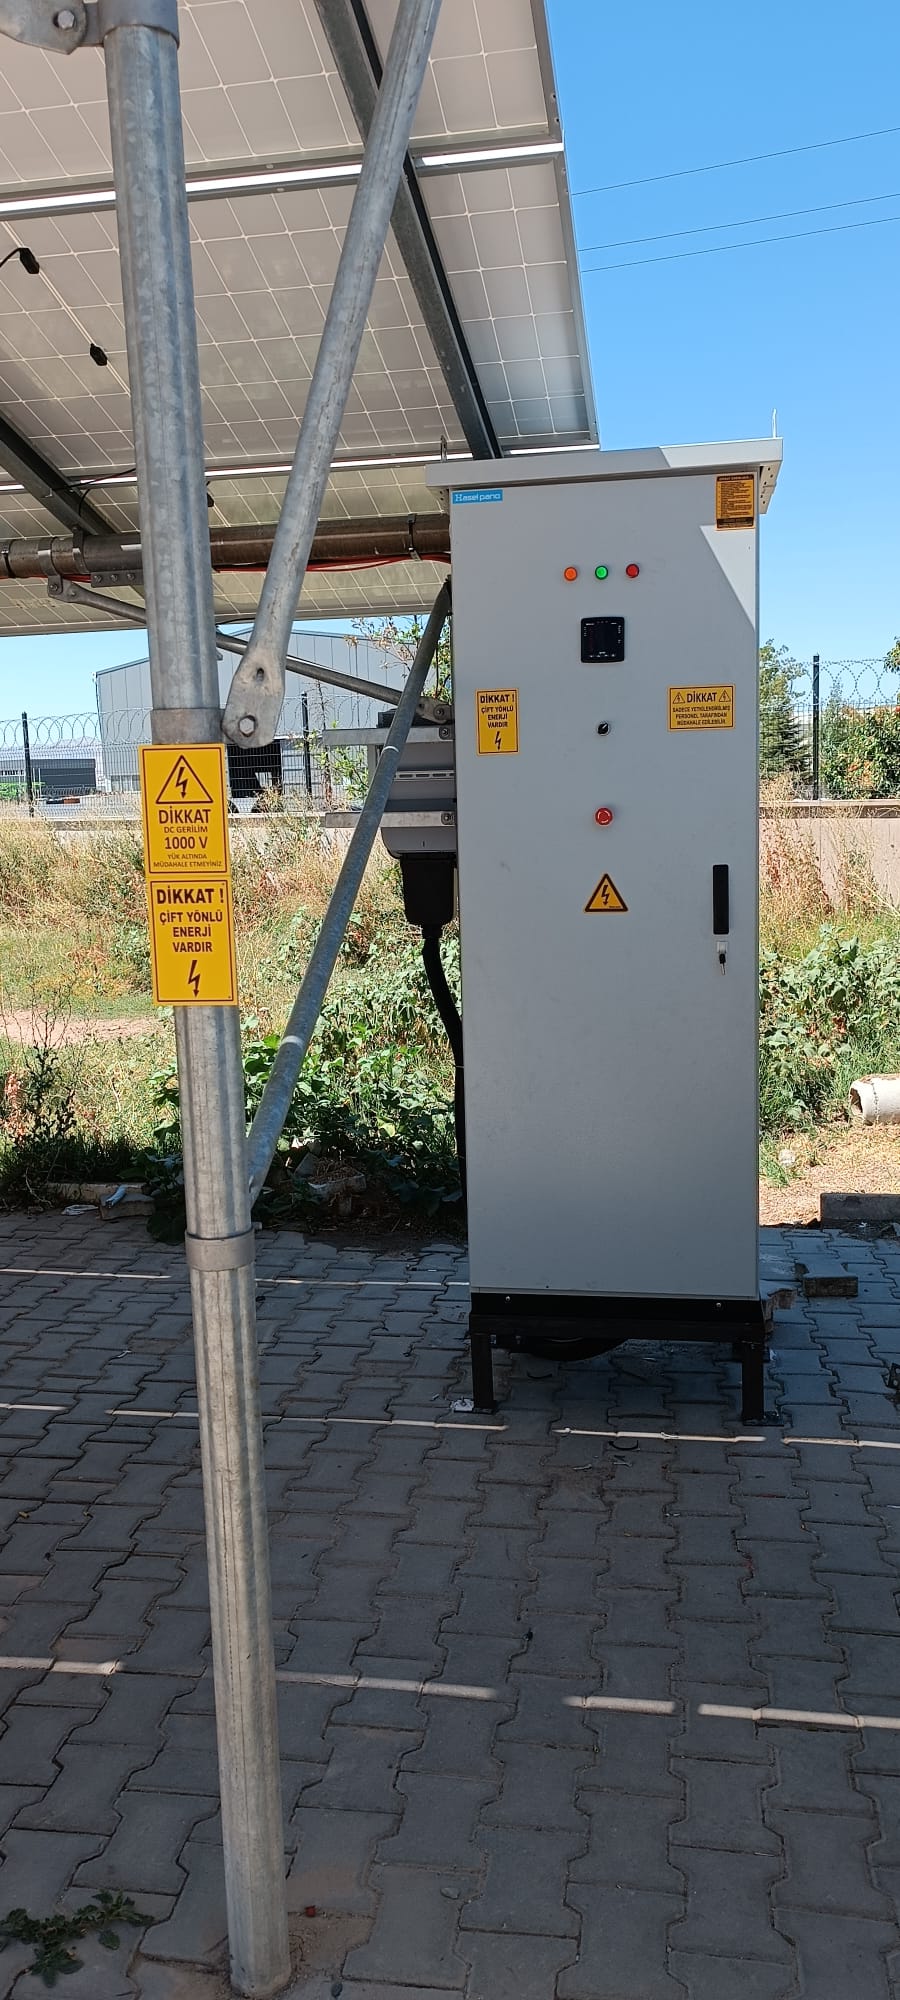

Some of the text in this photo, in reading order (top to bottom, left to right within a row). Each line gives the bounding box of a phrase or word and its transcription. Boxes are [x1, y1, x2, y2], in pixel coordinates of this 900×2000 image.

[480, 693, 510, 703] DİKKAT
[686, 690, 717, 703] DİKKAT
[158, 805, 212, 824] DİKKAT
[176, 824, 208, 833] GERİLİM
[164, 836, 208, 850] 1000 V
[167, 852, 208, 860] YÜK ALTINDA
[153, 859, 222, 868] MÜDAHALE ETMEYİNİZ
[156, 884, 215, 905] DİKKAT
[159, 908, 223, 926] ÇİFT YÖNLÜ
[172, 923, 212, 938] ENERJİ
[172, 941, 213, 953] VARDIR
